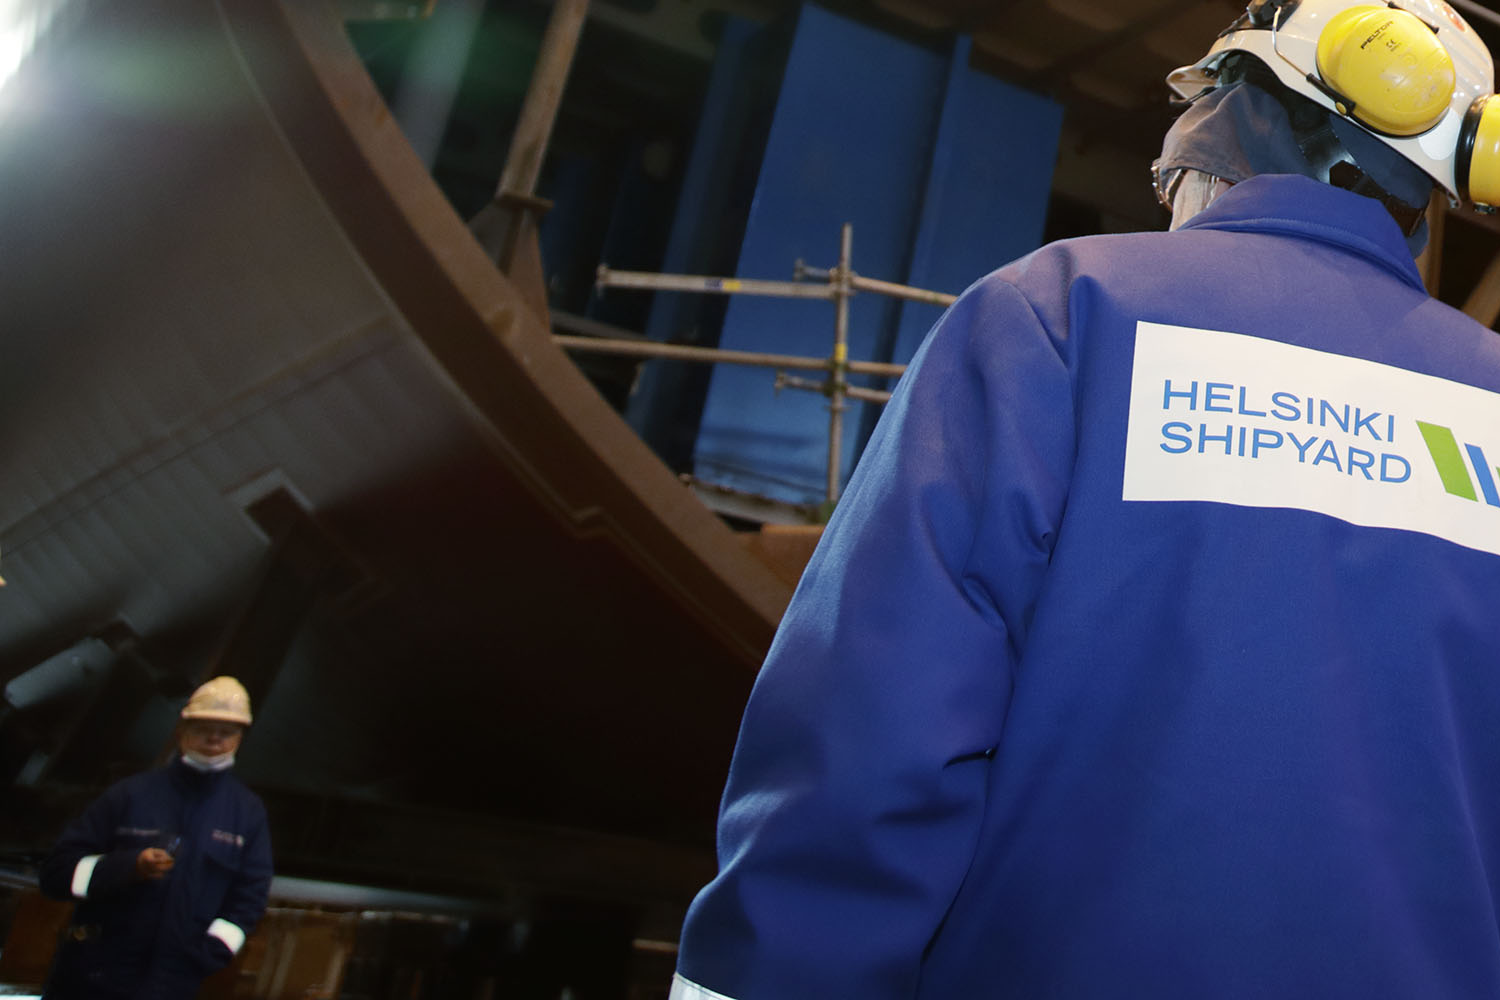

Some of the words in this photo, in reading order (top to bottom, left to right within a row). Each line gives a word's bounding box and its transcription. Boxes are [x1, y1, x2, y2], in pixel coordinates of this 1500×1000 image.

[1360, 20, 1394, 50] PELTOR
[1162, 378, 1395, 443] HELSINKI
[1159, 421, 1412, 484] SHIPYARD
